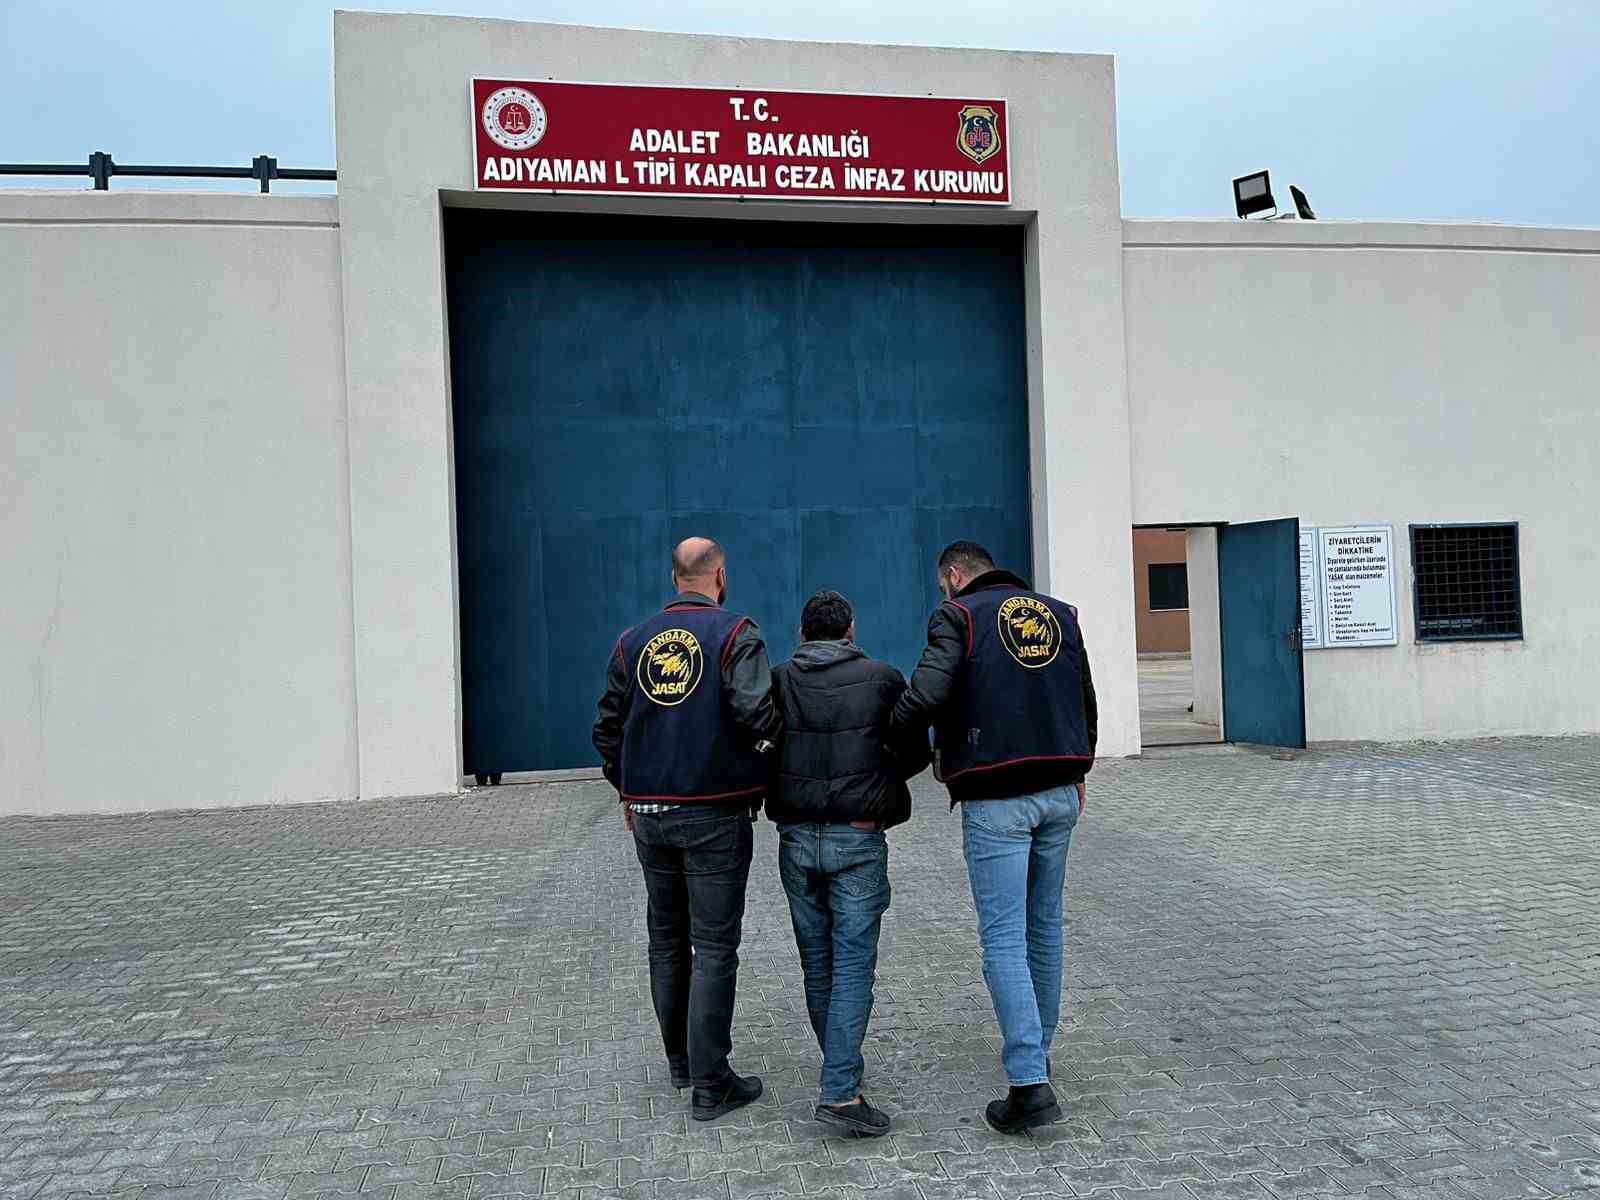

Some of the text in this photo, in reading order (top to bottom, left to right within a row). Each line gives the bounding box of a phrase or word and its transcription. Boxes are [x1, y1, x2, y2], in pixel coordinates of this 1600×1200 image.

[729, 97, 779, 122] T.C.
[629, 128, 869, 158] ADALET BAKANLIĞI
[483, 156, 1004, 194] ADIYAMAN L TİPİ KAPALI CEZA İNFAZ KURUMU
[1328, 536, 1381, 545] ZİYARETÇİLERİN
[1338, 547, 1374, 555] DİKKATİNE
[1000, 599, 1050, 620] JANDARMA
[647, 632, 698, 656] JANDARMA
[1018, 645, 1049, 657] JASAT
[652, 682, 687, 694] JASAT
